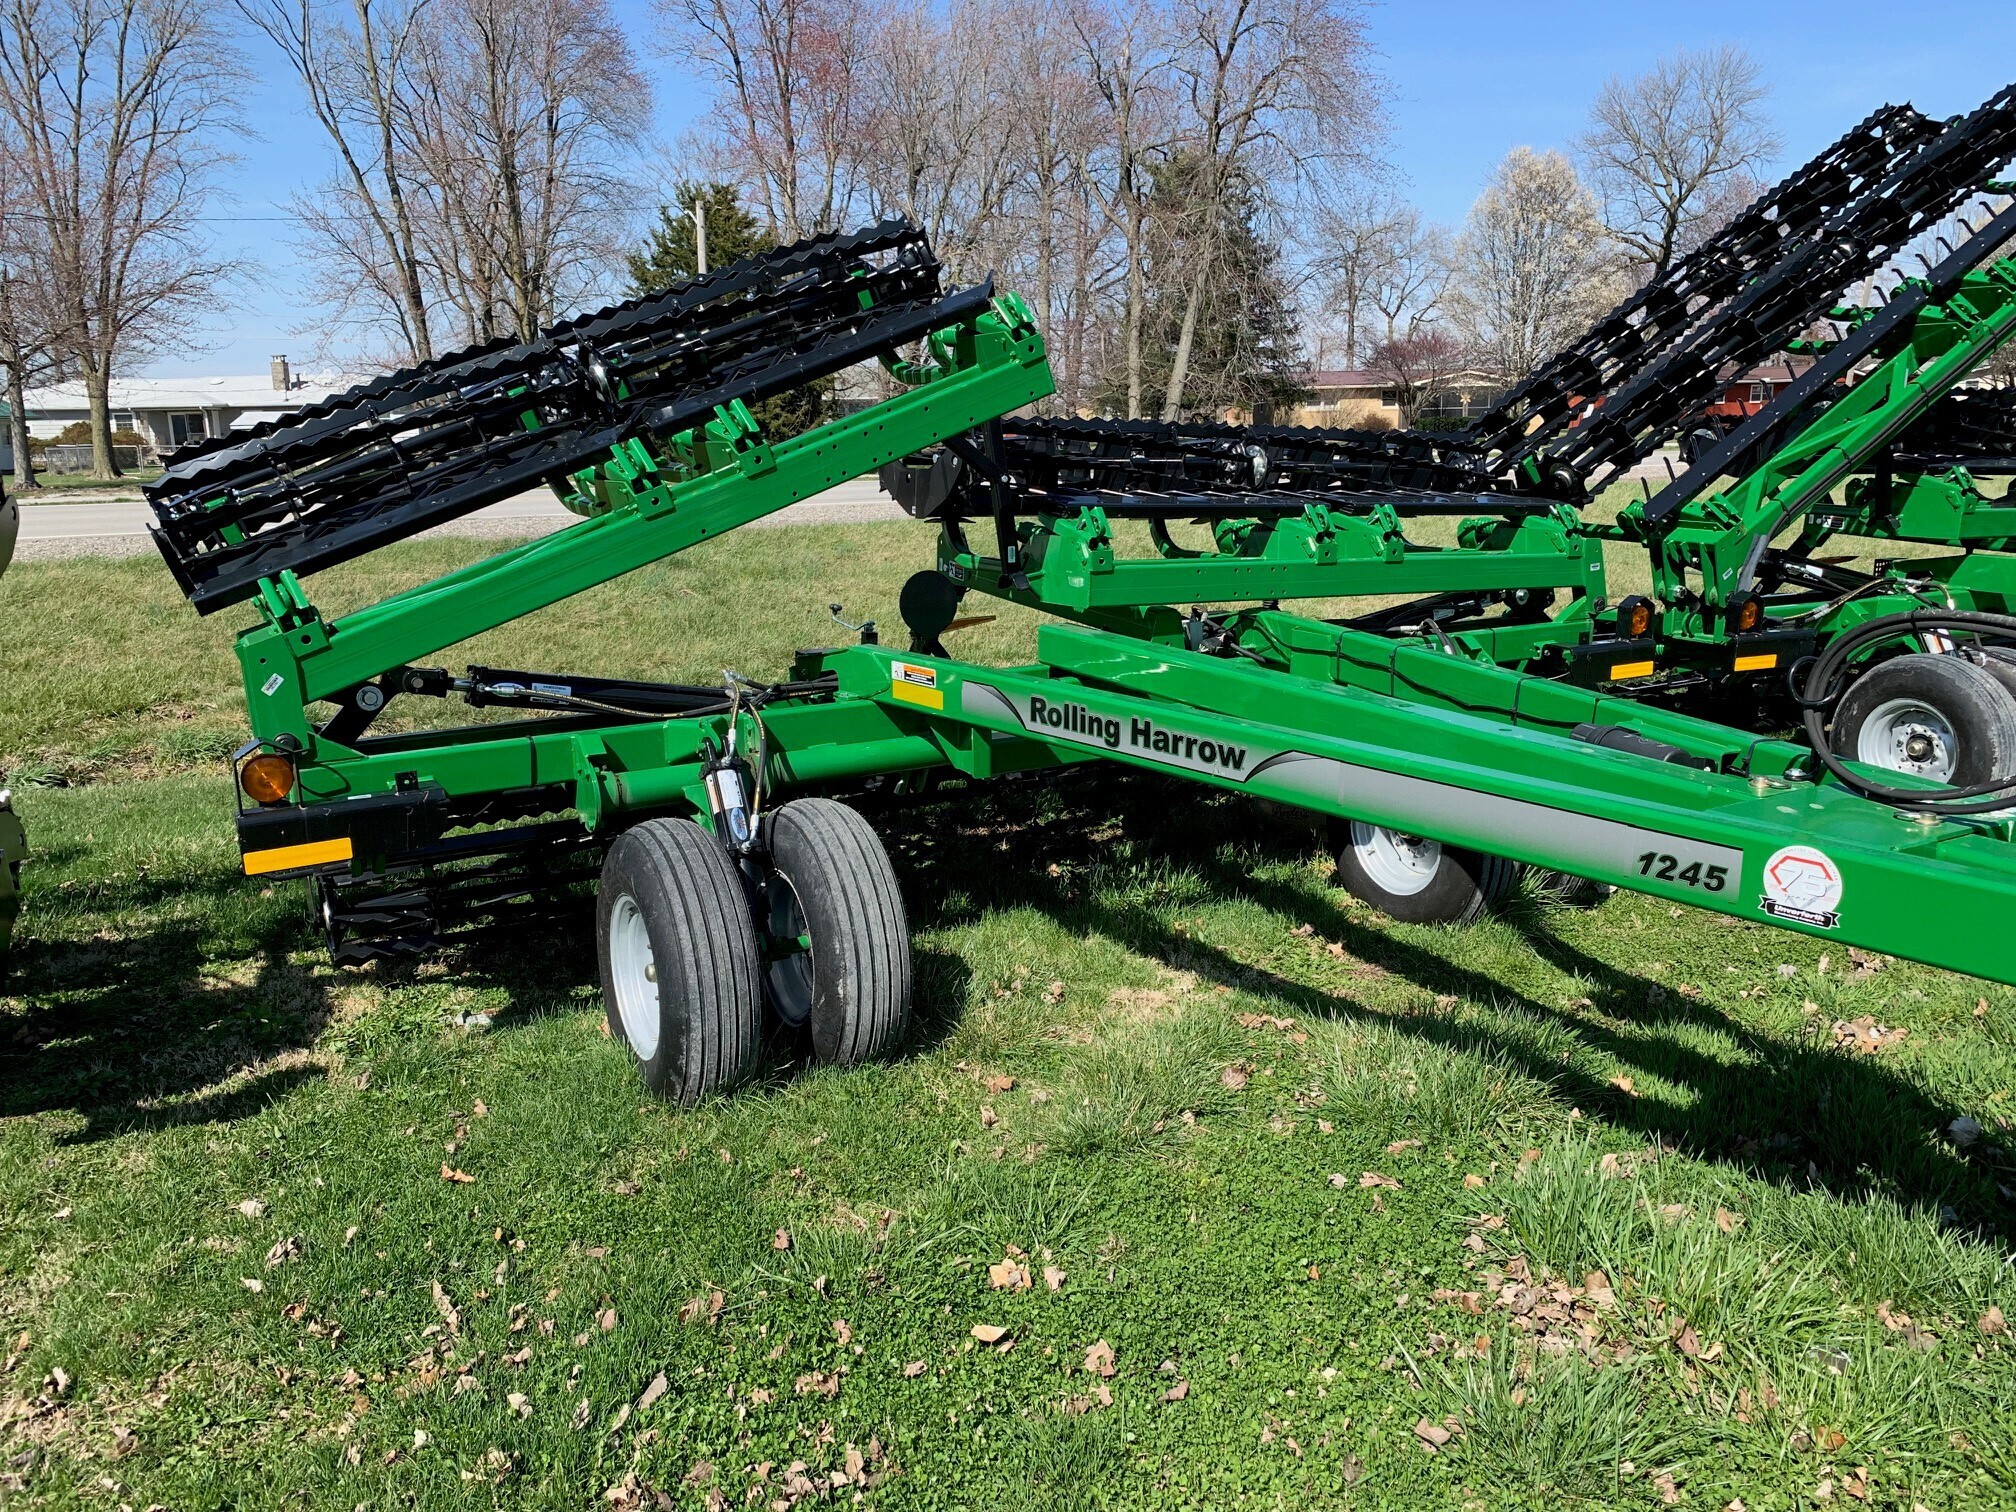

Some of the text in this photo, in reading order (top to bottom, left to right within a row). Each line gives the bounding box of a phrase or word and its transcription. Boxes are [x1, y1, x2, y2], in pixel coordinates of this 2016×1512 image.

[1029, 696, 1247, 771] Rolling Harrow
[1637, 850, 1729, 893] 1245
